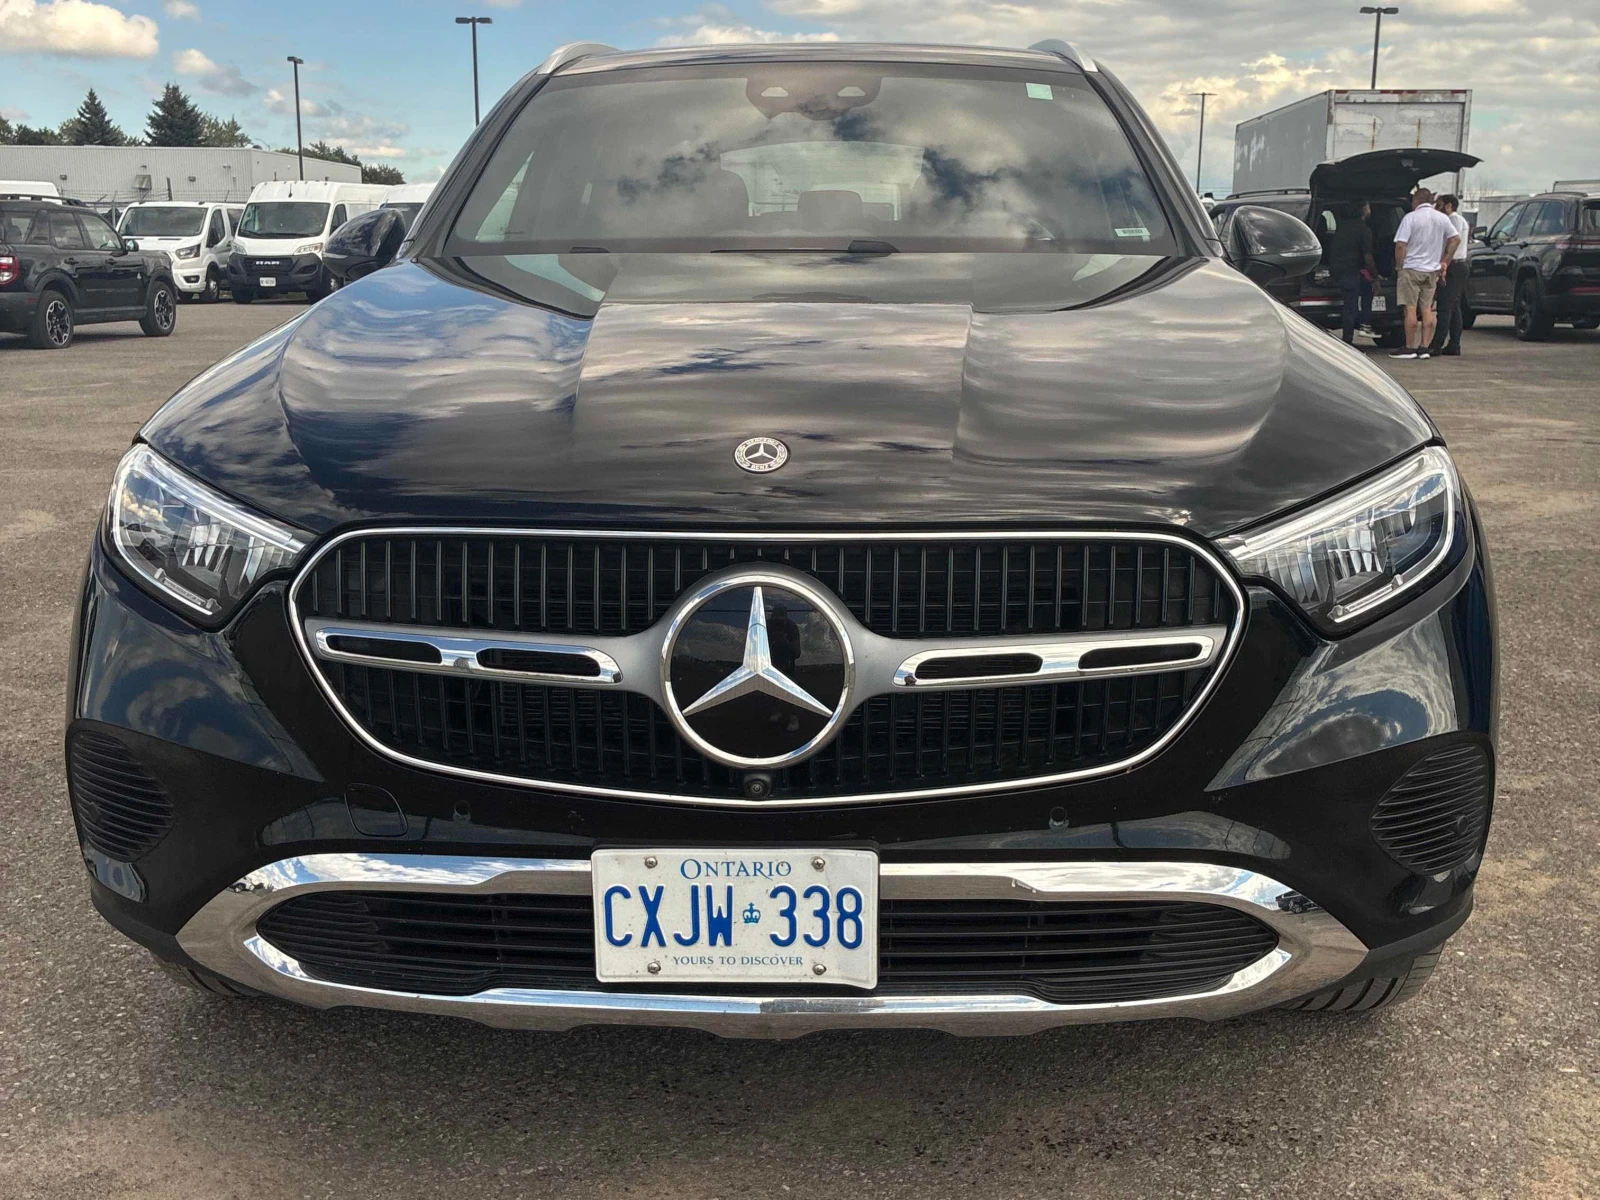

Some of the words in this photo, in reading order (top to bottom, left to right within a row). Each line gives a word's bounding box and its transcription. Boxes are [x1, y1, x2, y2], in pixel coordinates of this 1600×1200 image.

[680, 858, 792, 880] ONTARIO
[603, 884, 734, 948] CXJW
[769, 884, 864, 949] 338
[673, 956, 714, 965] YOURS
[720, 956, 736, 965] TO
[741, 956, 803, 966] DISCOVER
